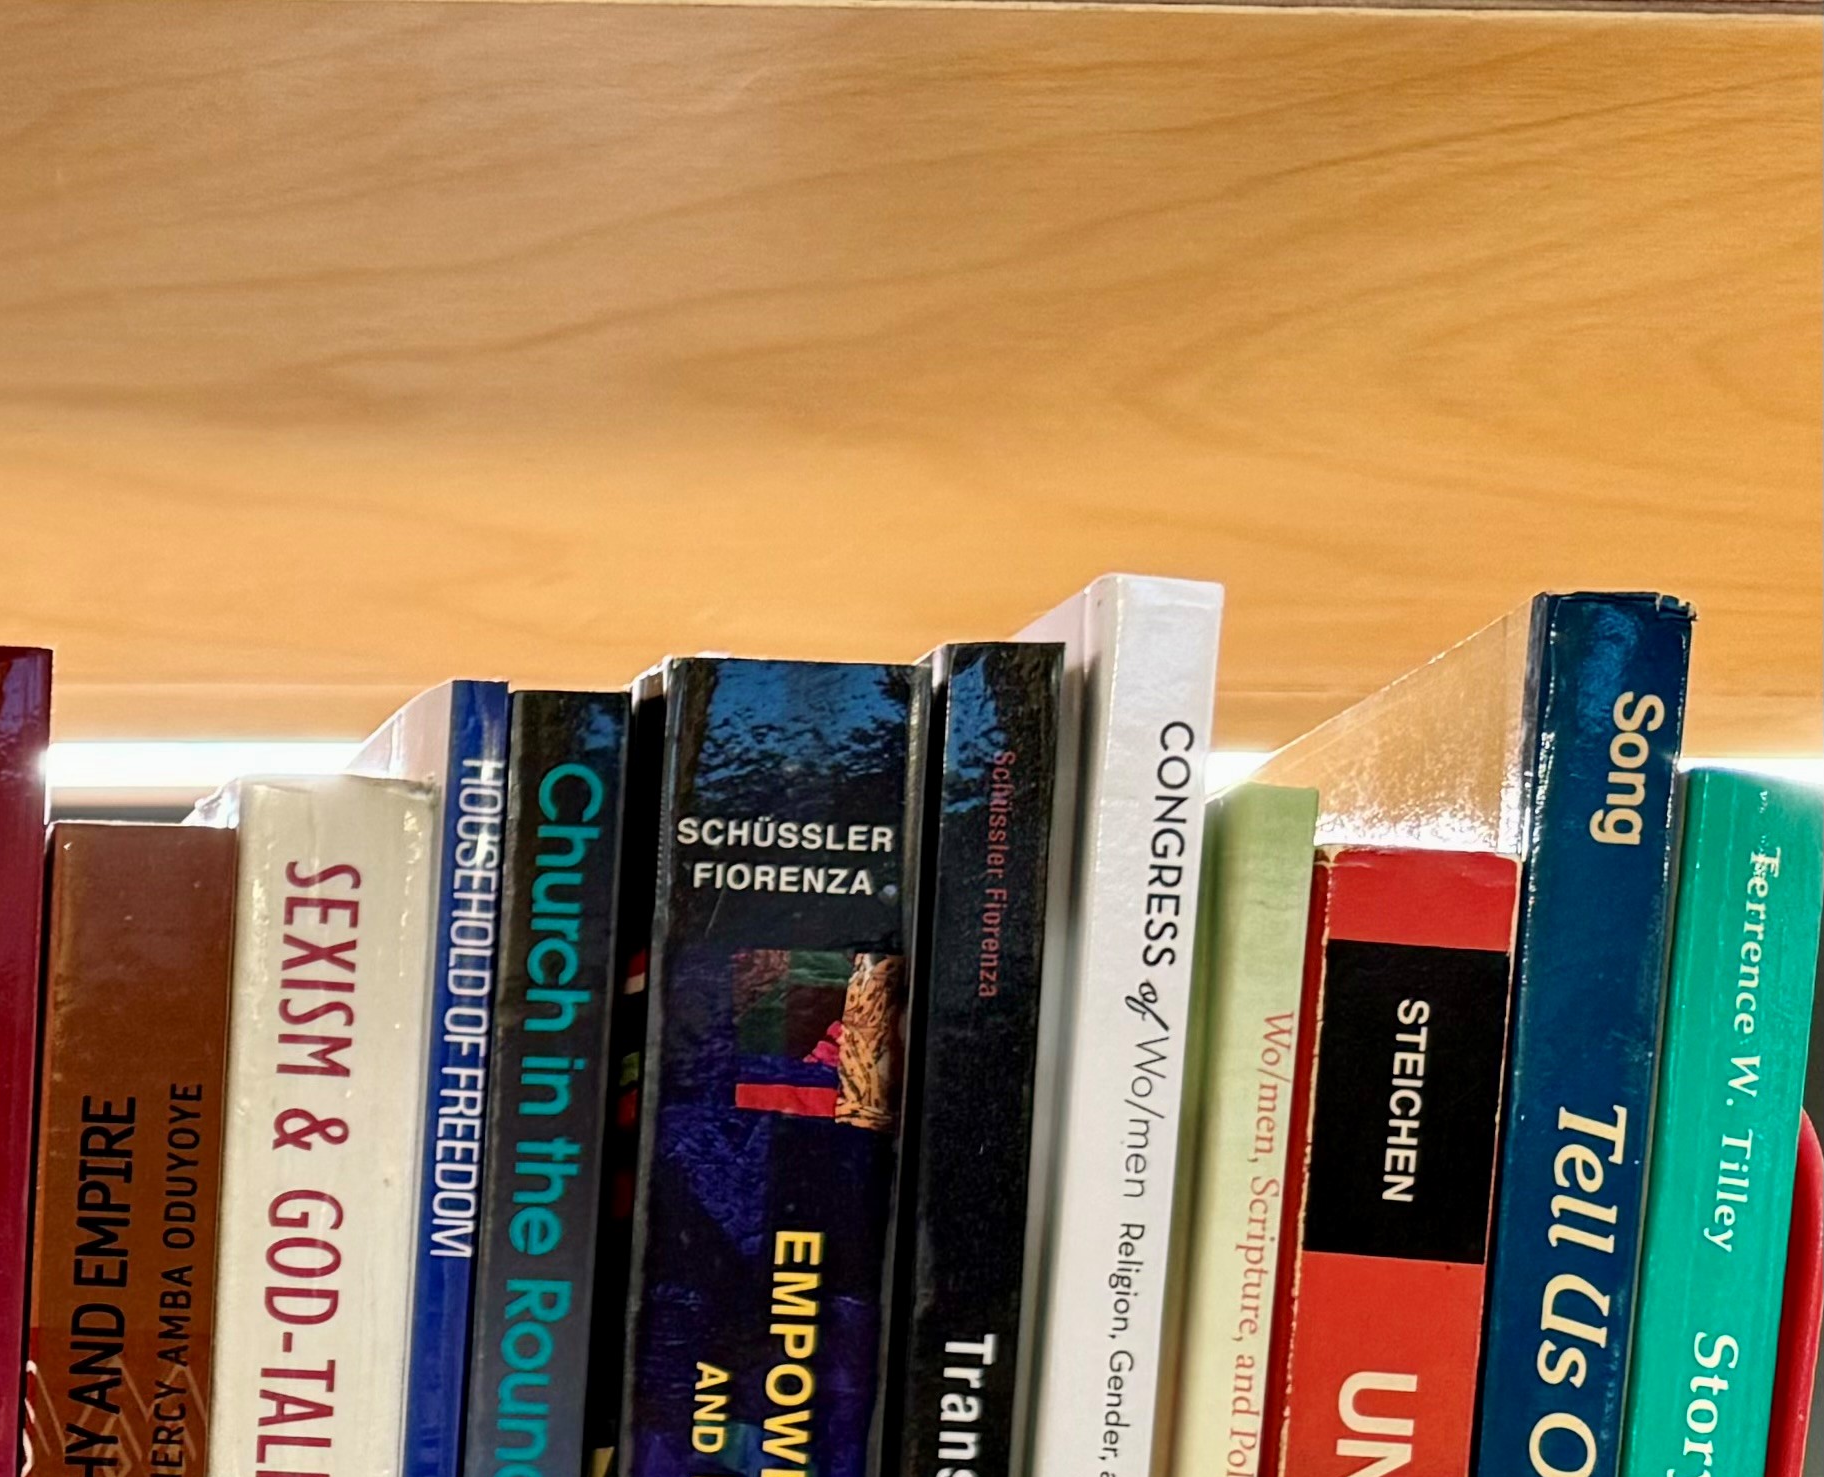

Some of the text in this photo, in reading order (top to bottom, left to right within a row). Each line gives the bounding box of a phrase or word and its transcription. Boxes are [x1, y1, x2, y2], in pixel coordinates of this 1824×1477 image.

[1590, 690, 1665, 847] Song
[678, 817, 893, 853] SCHÜSSLER
[694, 862, 873, 895] FIORENZA
[525, 763, 605, 1031] Church
[276, 862, 362, 1080] SEXISM
[1122, 720, 1194, 1200] CONGRESS of Wo/men
[273, 1108, 349, 1151] &
[519, 1056, 586, 1117] in
[1383, 998, 1430, 1202] STEICHEN
[74, 1092, 137, 1289] EMPIRE
[512, 1138, 580, 1255] the
[1549, 1106, 1628, 1254] Tell
[65, 1300, 127, 1412] AND
[1537, 1272, 1612, 1388] Us
[692, 1363, 727, 1456] AND
